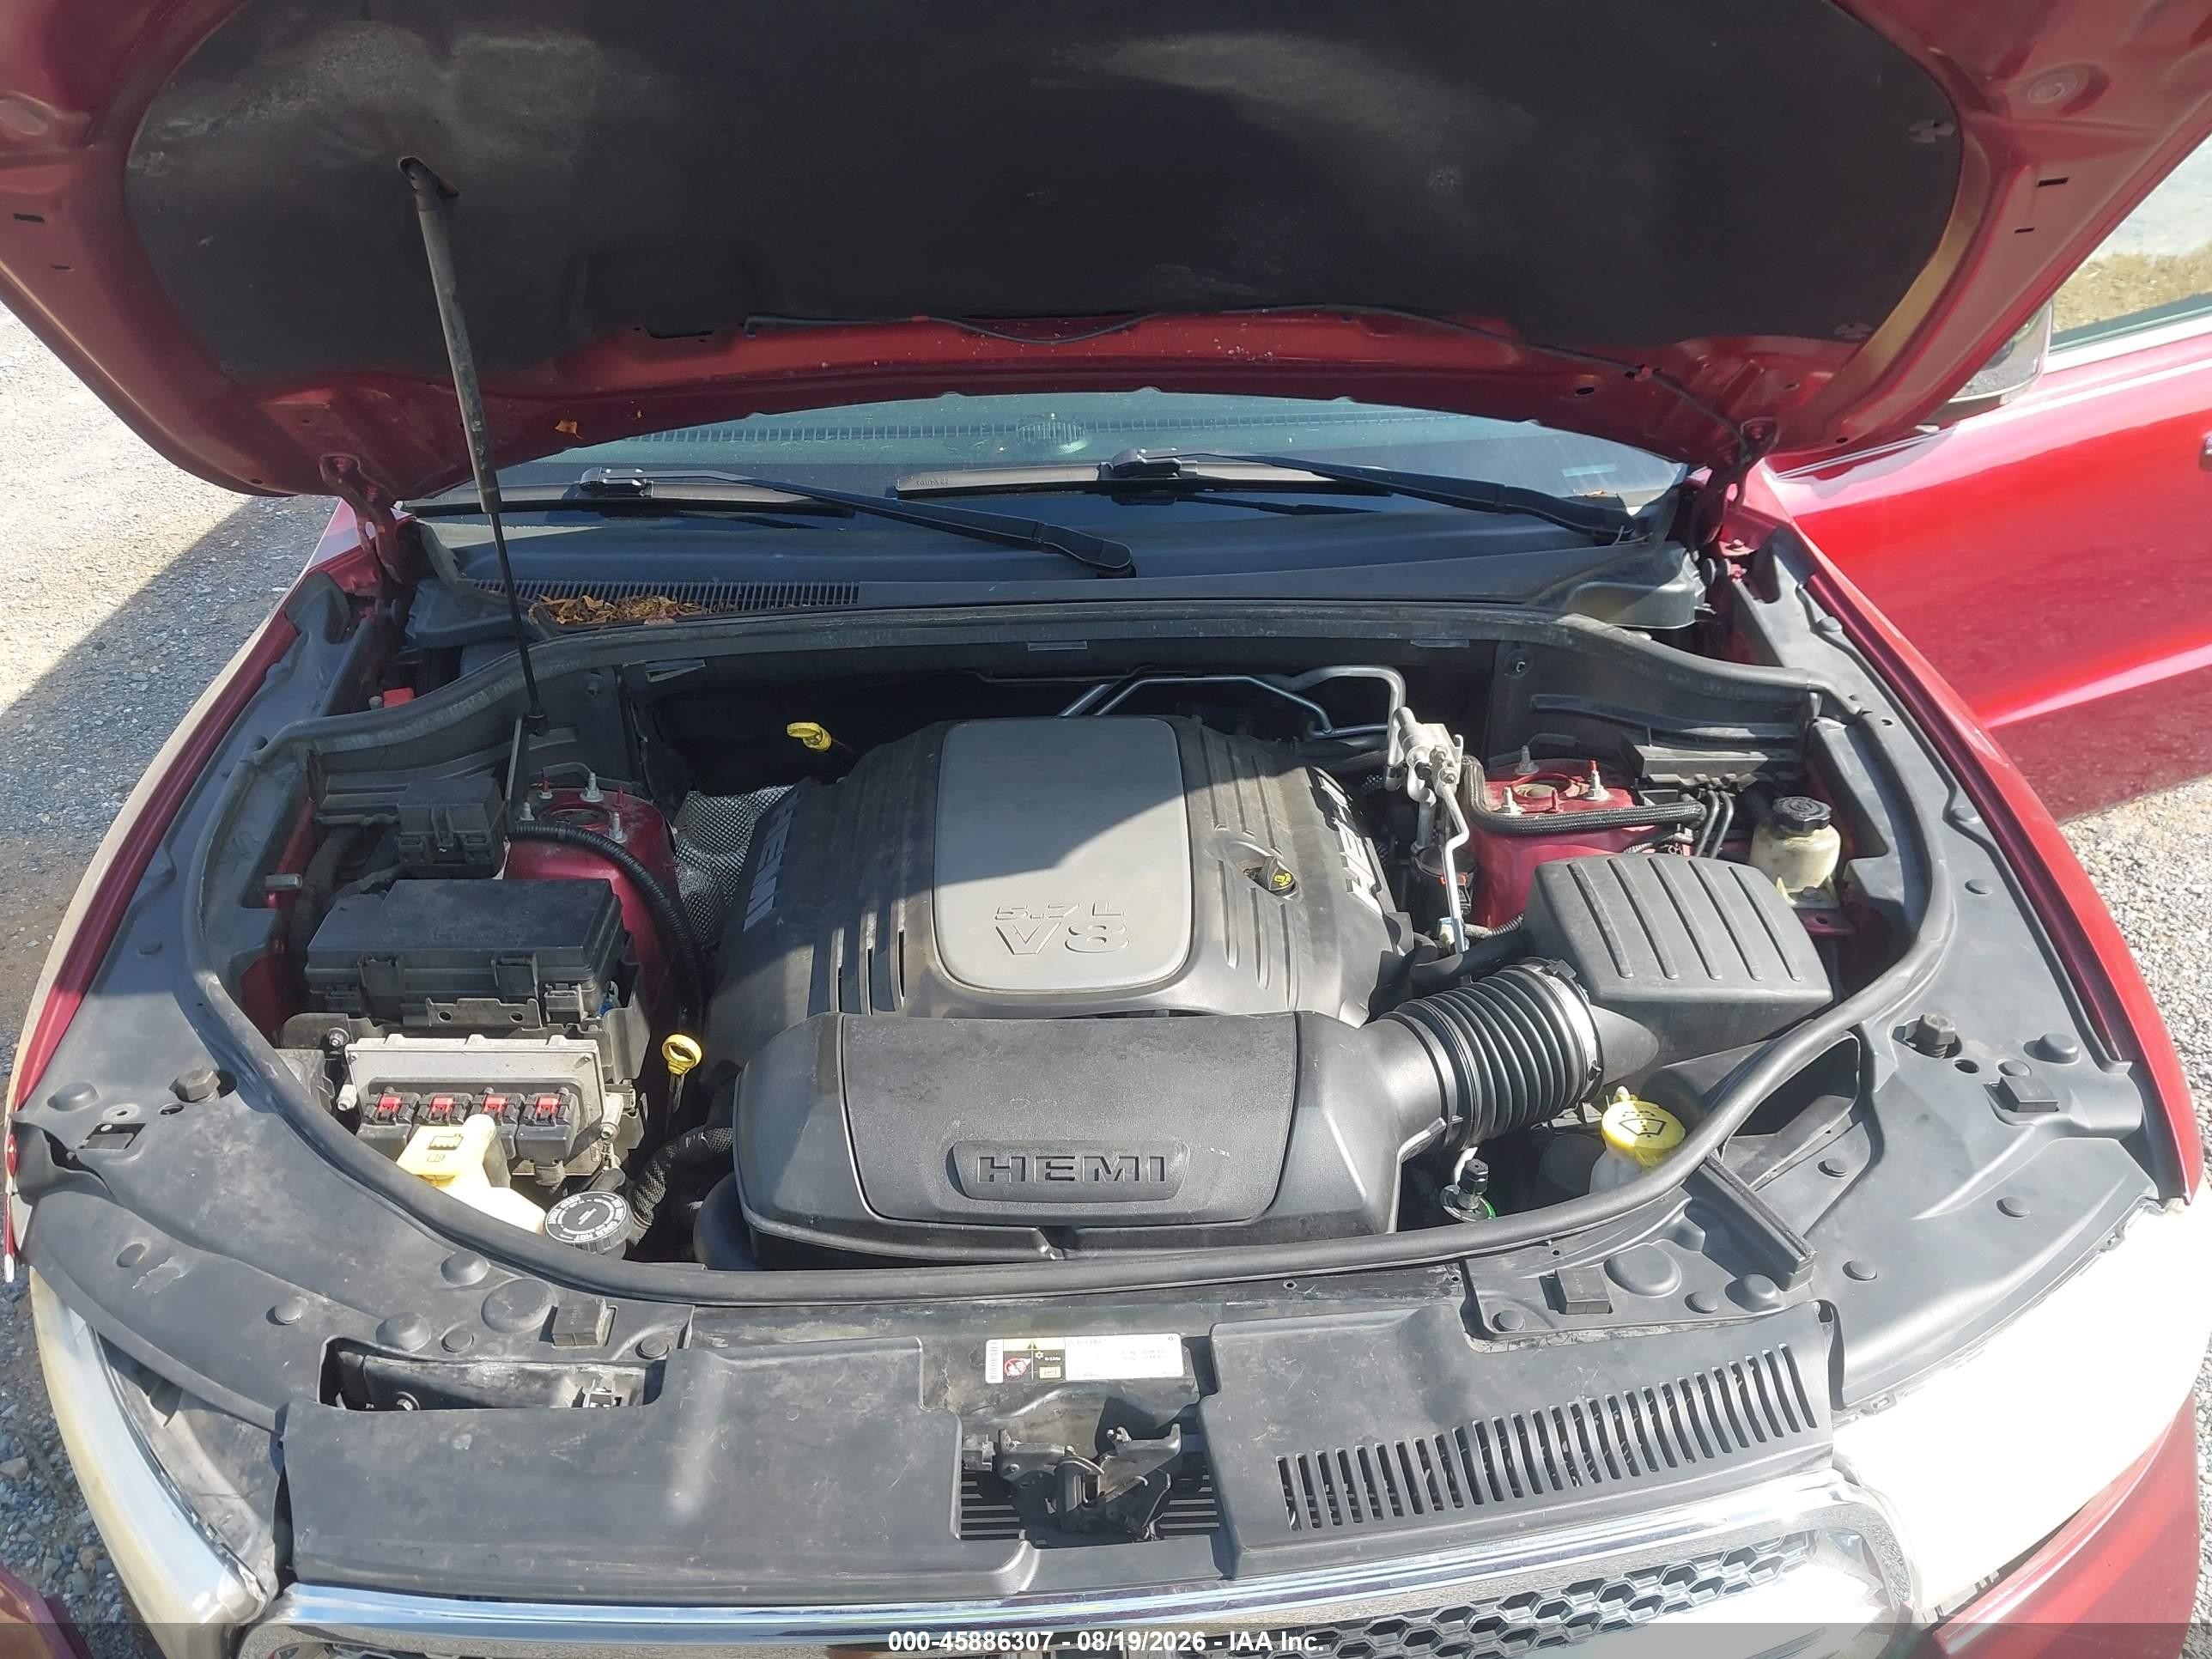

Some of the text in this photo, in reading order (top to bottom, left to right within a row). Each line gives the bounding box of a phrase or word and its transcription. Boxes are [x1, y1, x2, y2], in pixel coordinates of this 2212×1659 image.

[994, 921, 1130, 955] V8
[976, 1155, 1166, 1182] HEMI
[574, 1233, 593, 1242] HOT
